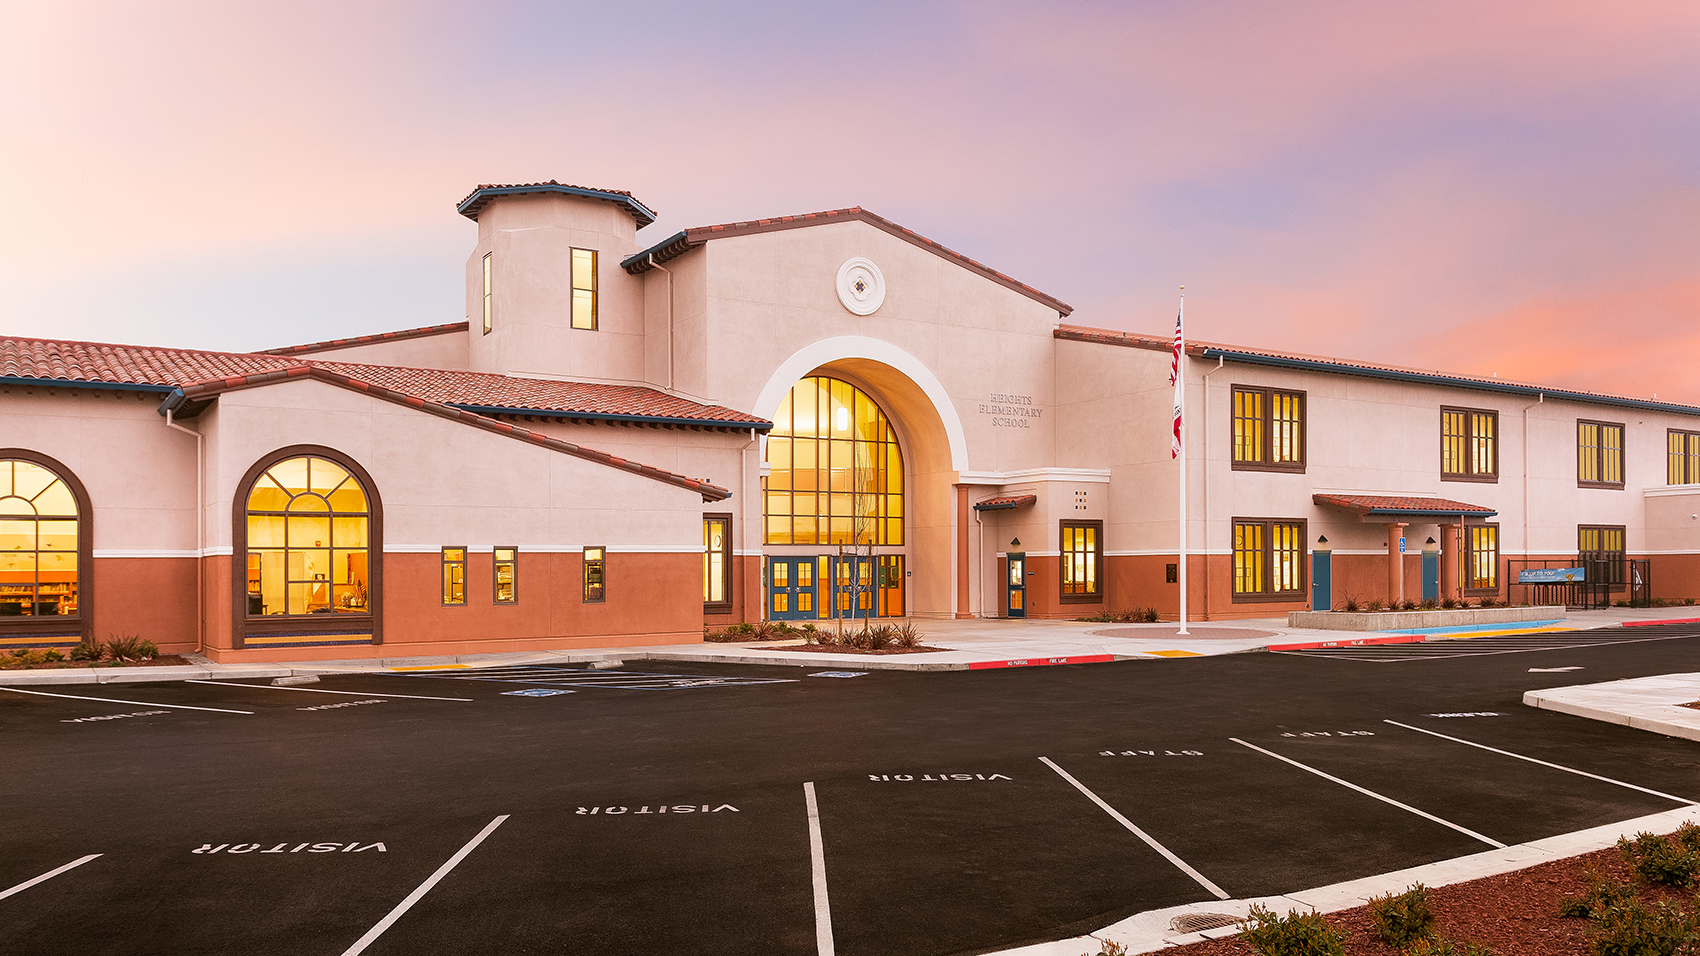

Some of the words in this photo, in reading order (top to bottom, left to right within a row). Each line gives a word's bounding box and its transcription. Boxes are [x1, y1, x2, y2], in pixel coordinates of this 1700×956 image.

[990, 393, 1032, 405] HEIGHTS
[979, 404, 1043, 417] ELEMENTARY
[992, 417, 1030, 428] SCHOOL
[868, 773, 1013, 781] VISITOR
[575, 804, 740, 815] VISITOR
[191, 842, 387, 854] VISITOR
